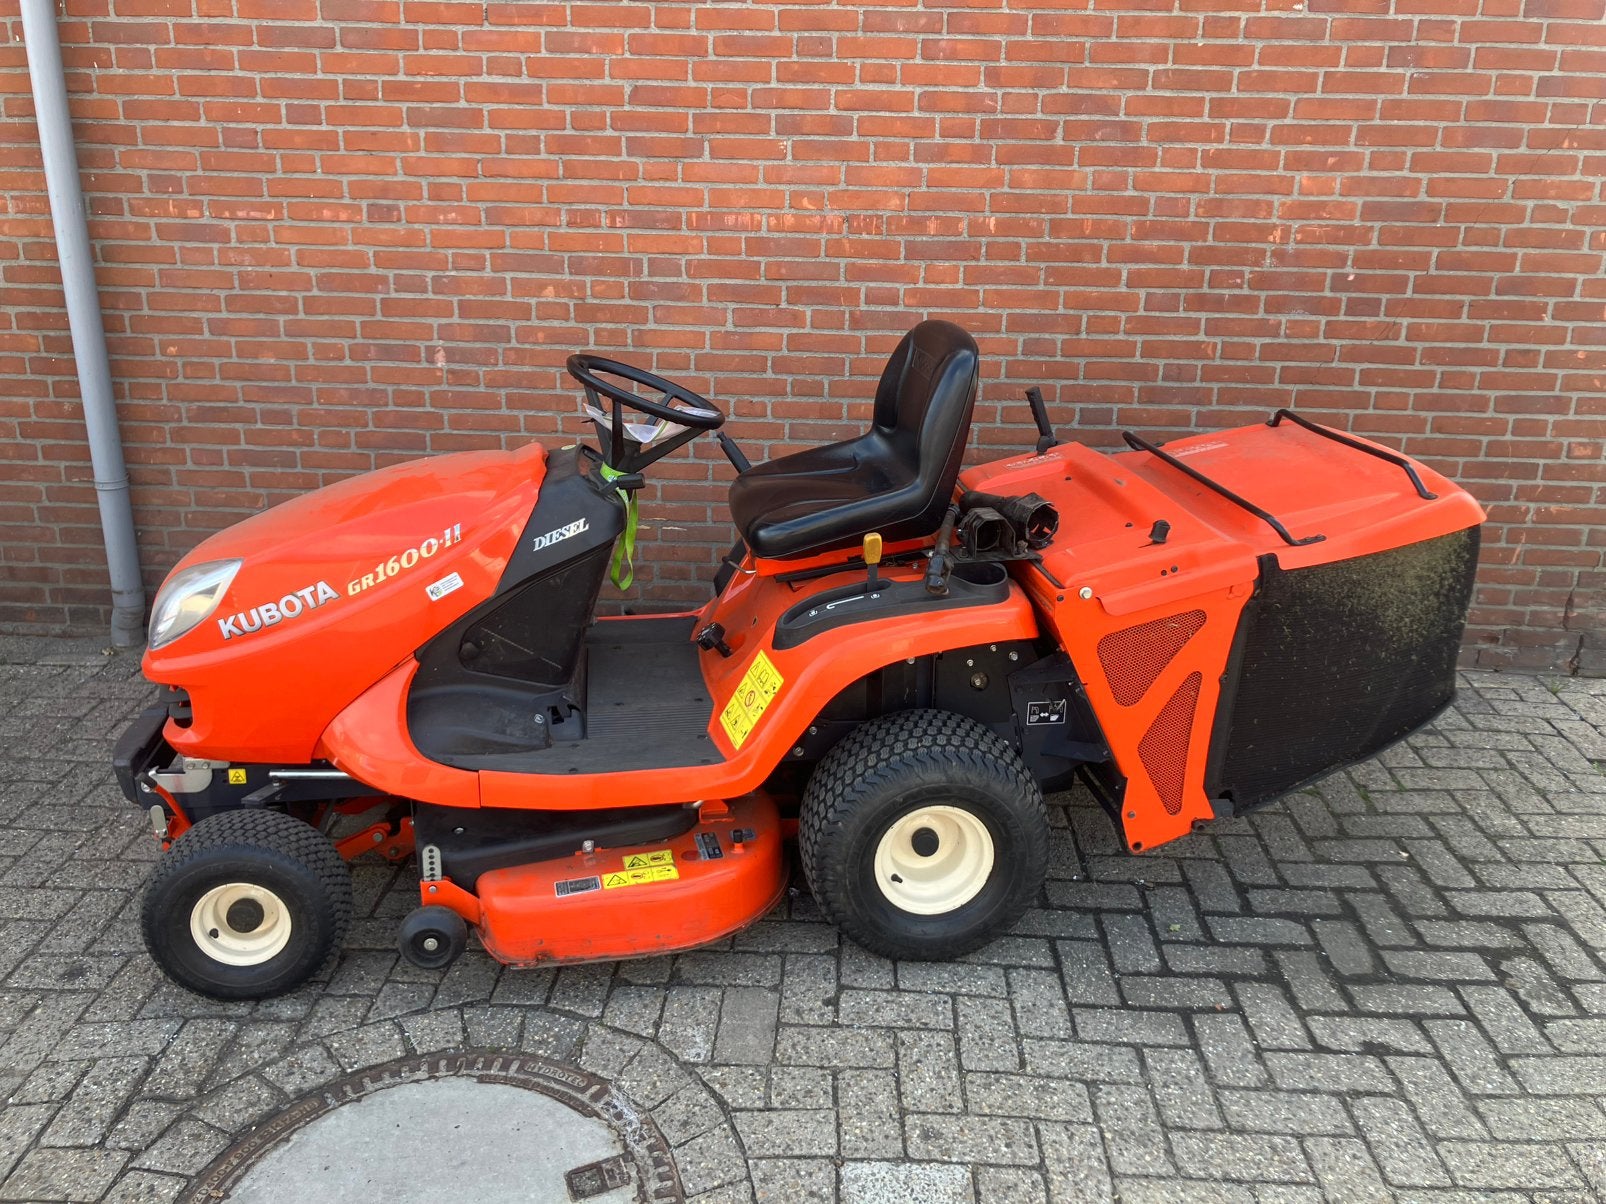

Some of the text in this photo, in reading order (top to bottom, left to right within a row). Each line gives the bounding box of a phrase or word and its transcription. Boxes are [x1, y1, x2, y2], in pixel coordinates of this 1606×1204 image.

[533, 517, 590, 552] DIESEL
[217, 580, 340, 640] KUBOTA
[526, 1062, 586, 1087] HYDROTEC
